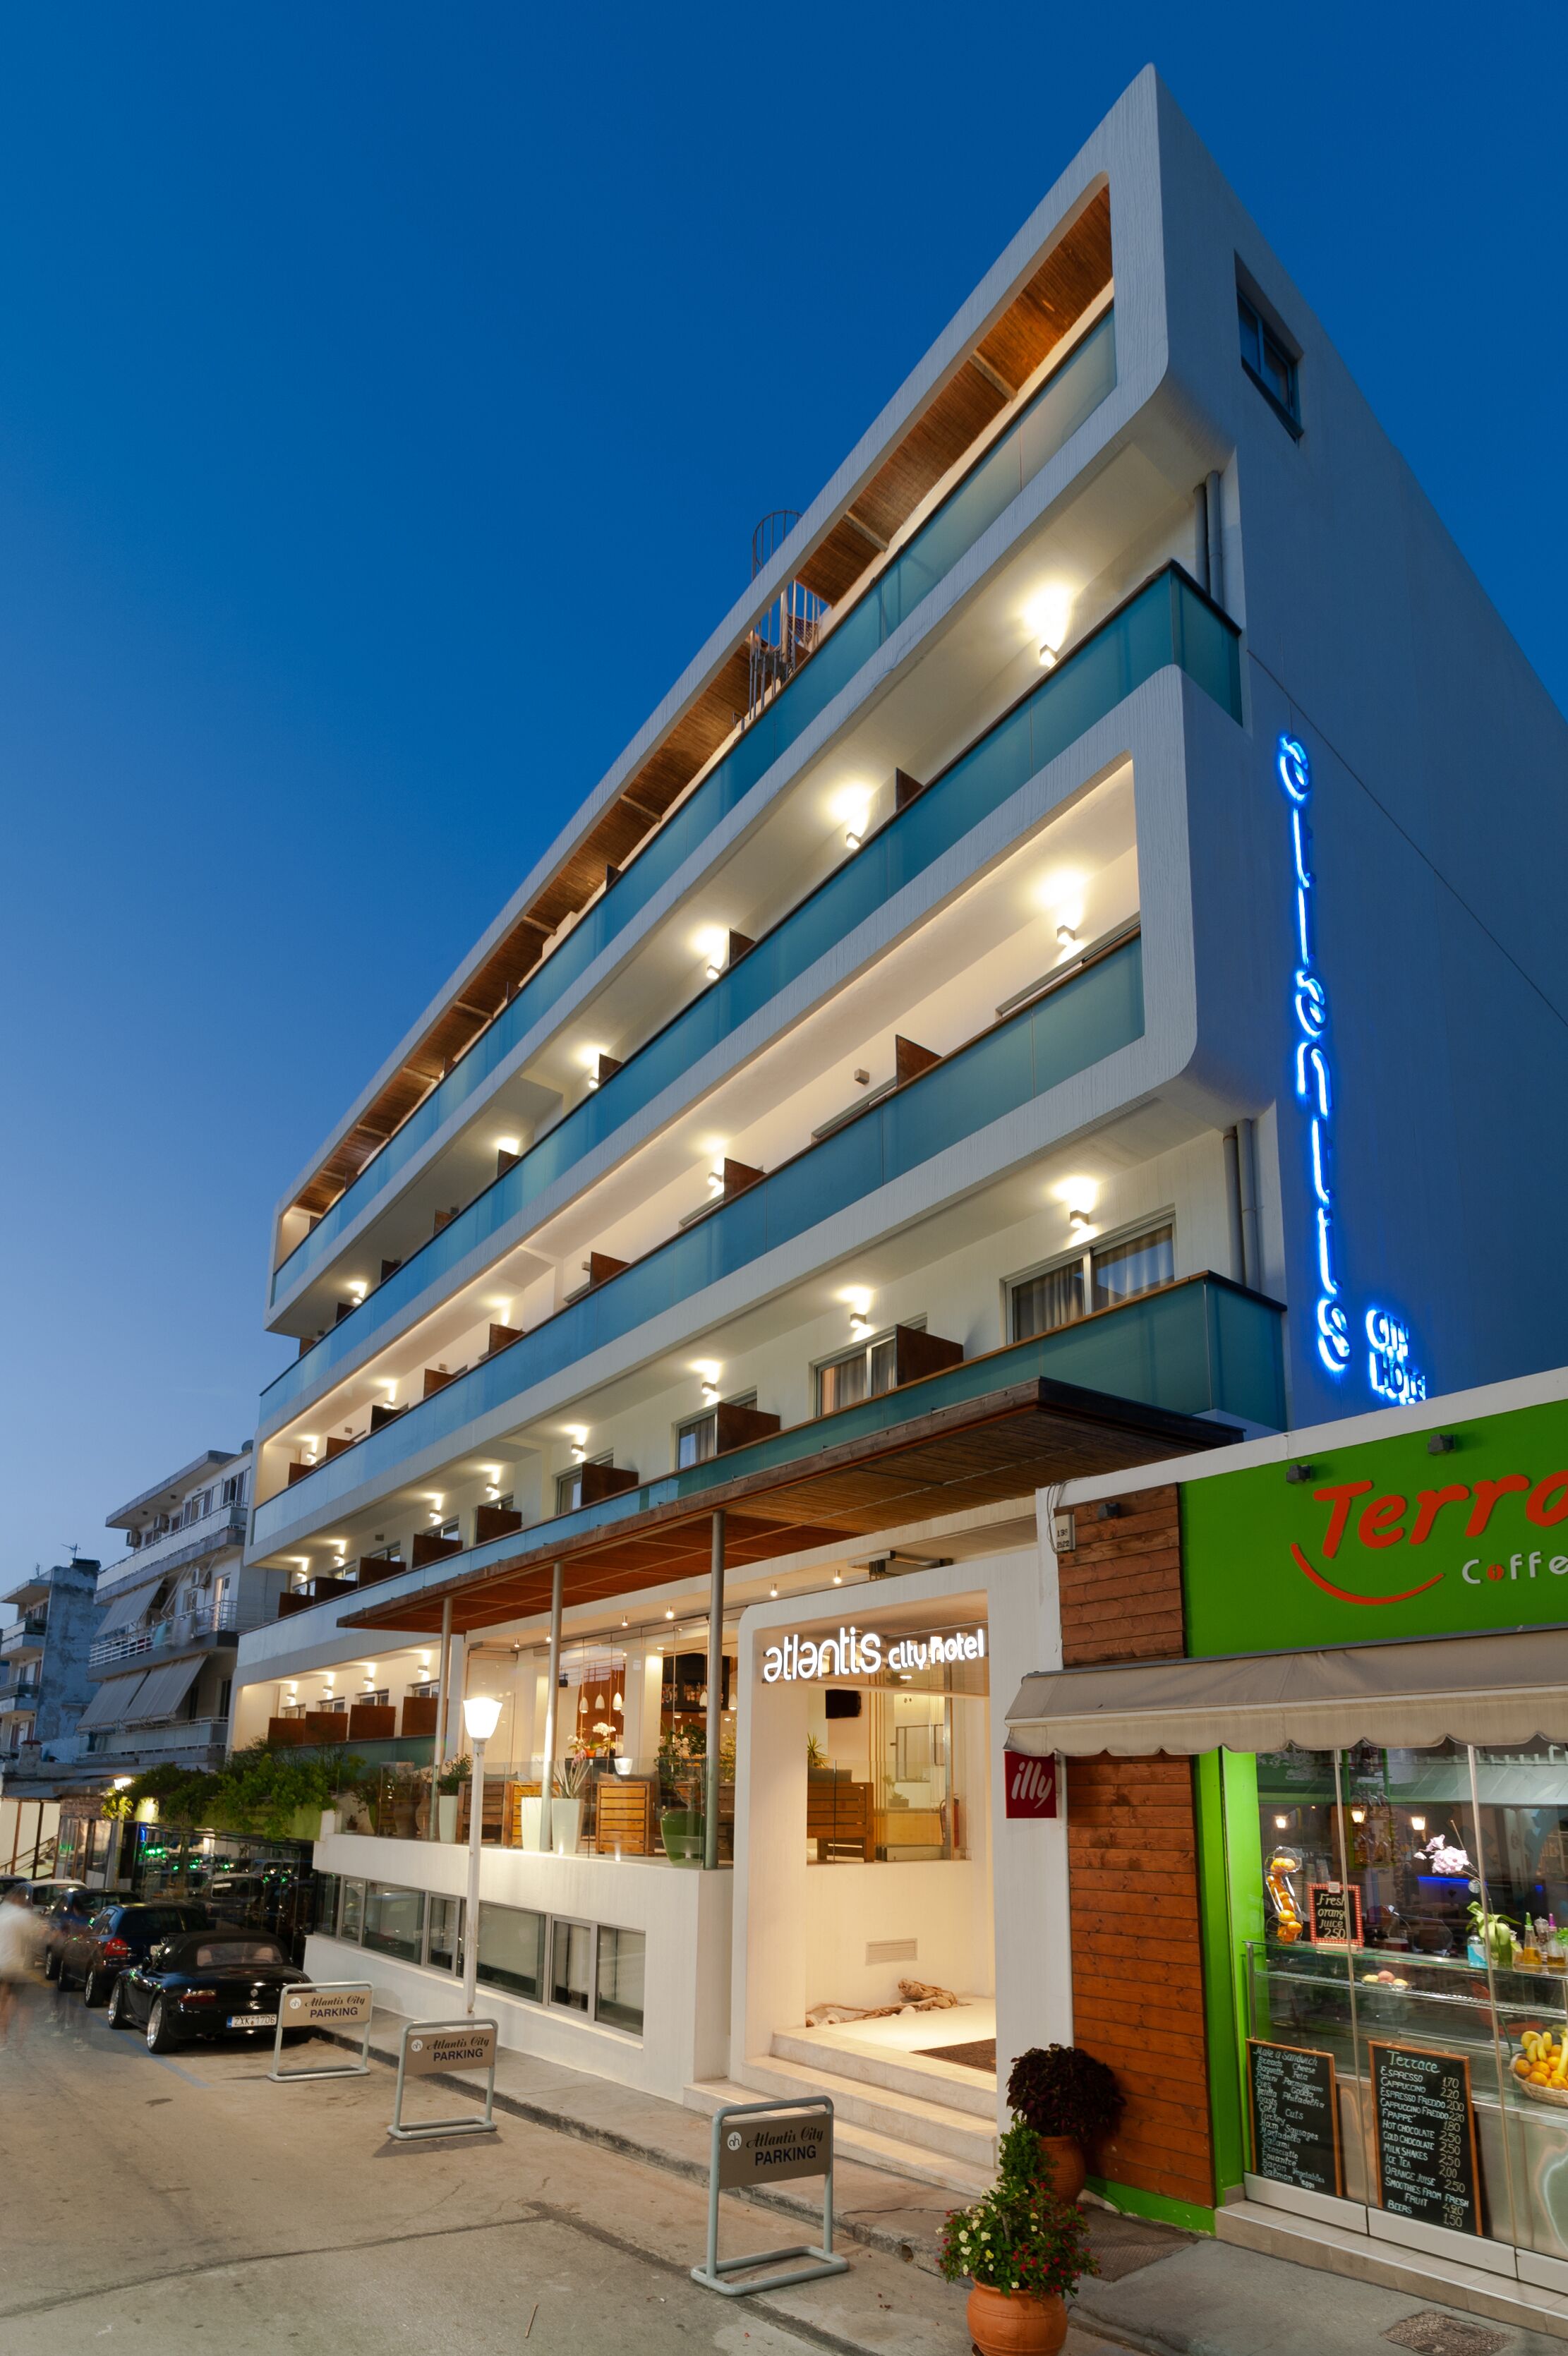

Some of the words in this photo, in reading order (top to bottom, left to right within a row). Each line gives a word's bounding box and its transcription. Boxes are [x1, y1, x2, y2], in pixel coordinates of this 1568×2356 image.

[764, 1626, 881, 1682] atlantis
[888, 1641, 927, 1669] city
[930, 1629, 984, 1664] hotel
[1011, 1760, 1053, 1809] illy
[305, 1997, 343, 2007] Atlantis
[347, 1995, 366, 2005] City
[310, 2007, 358, 2018] PARKING
[427, 2038, 467, 2050] Atlantis
[471, 2036, 489, 2048] City
[433, 2048, 483, 2062] PARKING
[1387, 2050, 1441, 2073] Terrace
[1380, 2065, 1423, 2083] ESPRESSO
[1380, 2086, 1416, 2103] ESPRESSO
[1418, 2095, 1446, 2109] FREDDO
[1422, 2106, 1449, 2120] FREDDO
[1382, 2119, 1397, 2130] HOT
[1397, 2122, 1435, 2139] CHOCOLATE
[747, 2130, 796, 2148] Atlantis
[801, 2127, 824, 2142] City
[1383, 2131, 1399, 2142] COLD
[1399, 2134, 1435, 2150] CHOCOLATE
[755, 2145, 816, 2165] PARKING
[1385, 2154, 1397, 2165] ICE
[1398, 2156, 1411, 2168] TEA
[1404, 2192, 1428, 2207] FRUIT
[1422, 2187, 1442, 2200] FROM
[1387, 2199, 1412, 2214] BEERS
